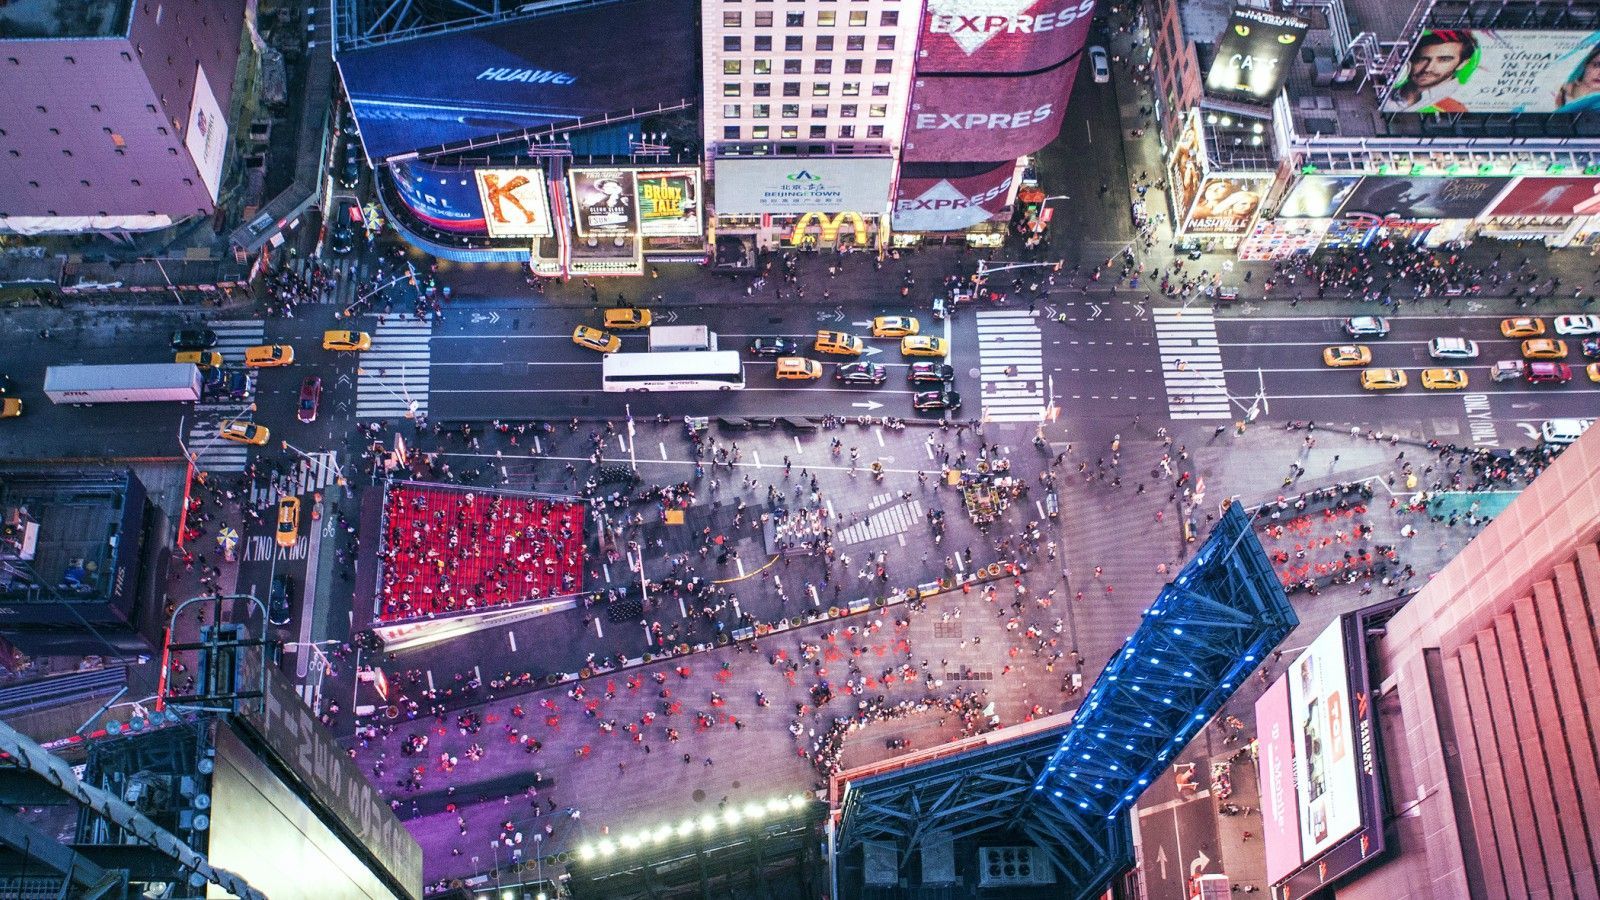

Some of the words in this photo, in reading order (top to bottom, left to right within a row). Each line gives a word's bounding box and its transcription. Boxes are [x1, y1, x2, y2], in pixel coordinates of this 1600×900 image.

[929, 0, 1095, 34] EXPRESS
[1229, 54, 1278, 73] CATS
[476, 67, 577, 85] HUAWEI
[643, 184, 682, 199] BRONX
[901, 176, 1013, 211] EXPRESS
[652, 199, 680, 212] TALE
[1188, 218, 1249, 228] NASHVILLE
[1464, 395, 1492, 419] ONLY
[1470, 423, 1499, 447] ONLY
